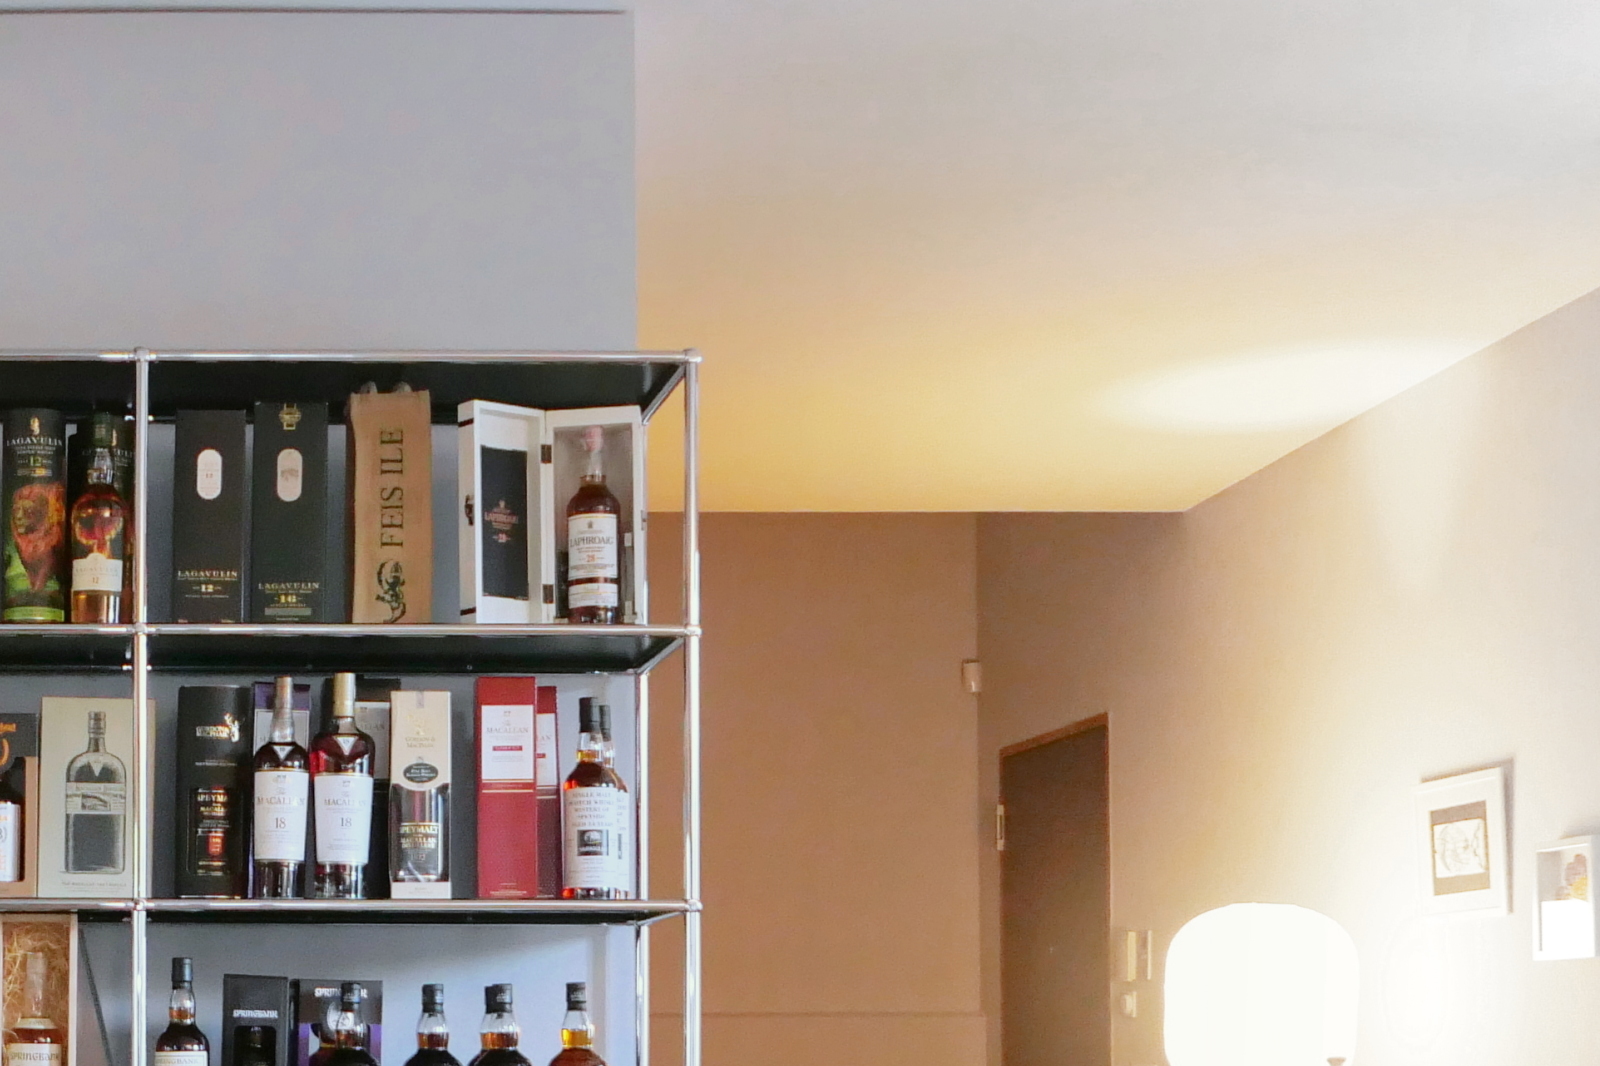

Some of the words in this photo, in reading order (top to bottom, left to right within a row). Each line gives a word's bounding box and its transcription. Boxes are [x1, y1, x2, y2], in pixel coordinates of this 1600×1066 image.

[7, 436, 63, 447] LAGAVULIN
[381, 429, 403, 475] ILE
[381, 487, 403, 549] FEIS
[569, 537, 615, 548] LAPHROAIG
[177, 570, 238, 578] LAGAVULIN
[200, 584, 214, 592] 12
[258, 582, 320, 590] LAGAVULIN
[257, 796, 305, 806] MACALLAN
[324, 798, 367, 807] MACALLAN
[275, 817, 287, 829] 18
[341, 817, 352, 828] 18
